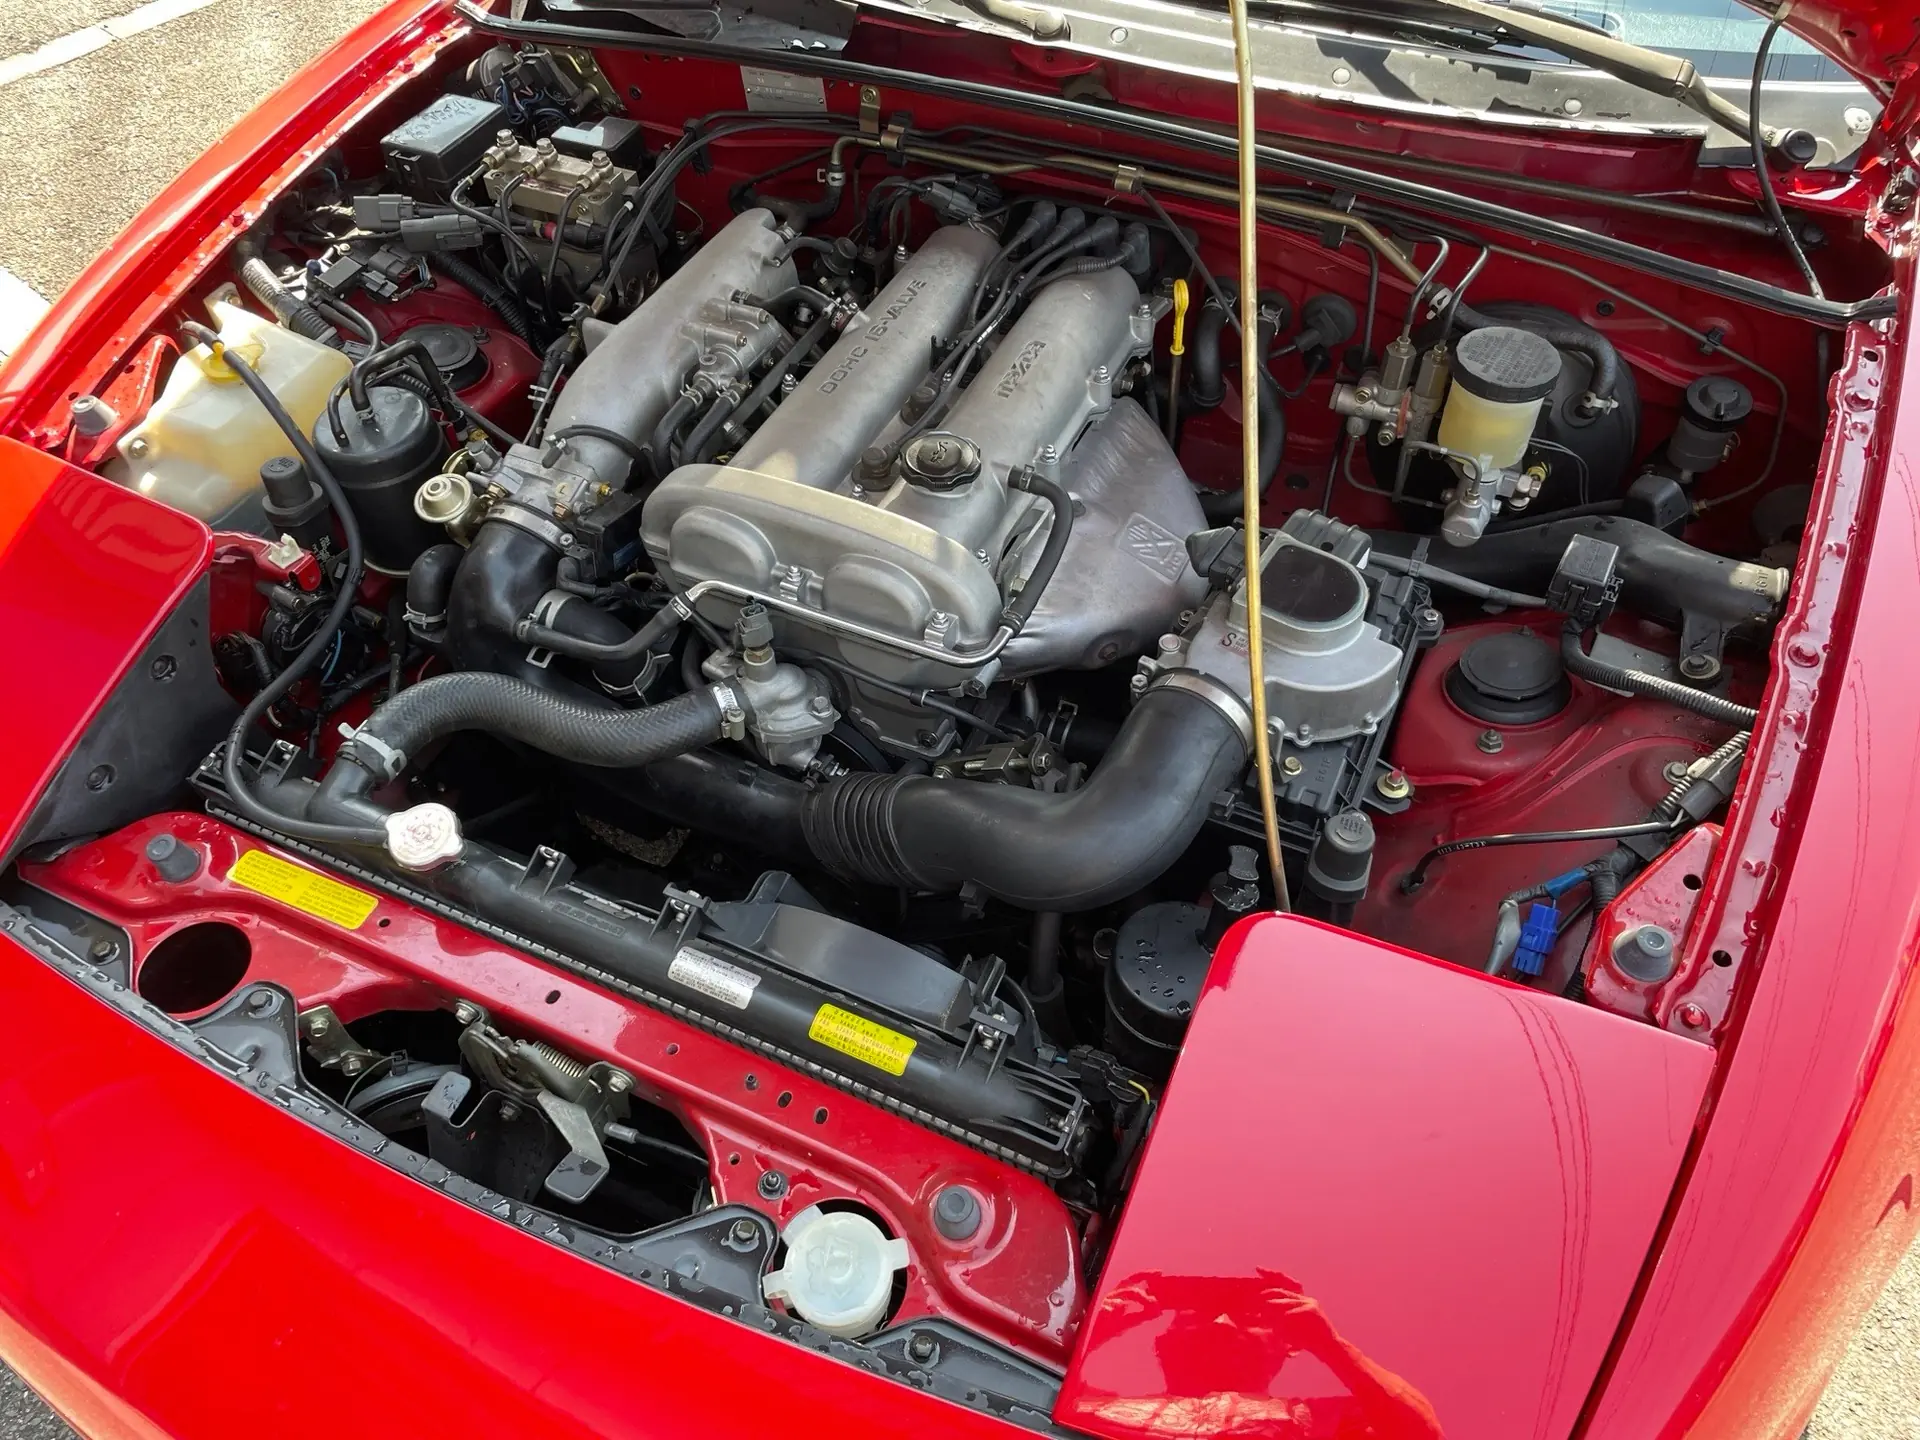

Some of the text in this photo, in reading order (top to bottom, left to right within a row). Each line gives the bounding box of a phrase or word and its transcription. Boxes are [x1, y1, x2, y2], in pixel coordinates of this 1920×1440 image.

[819, 279, 927, 396] DOHC 16-VALVE
[1221, 632, 1237, 647] S
